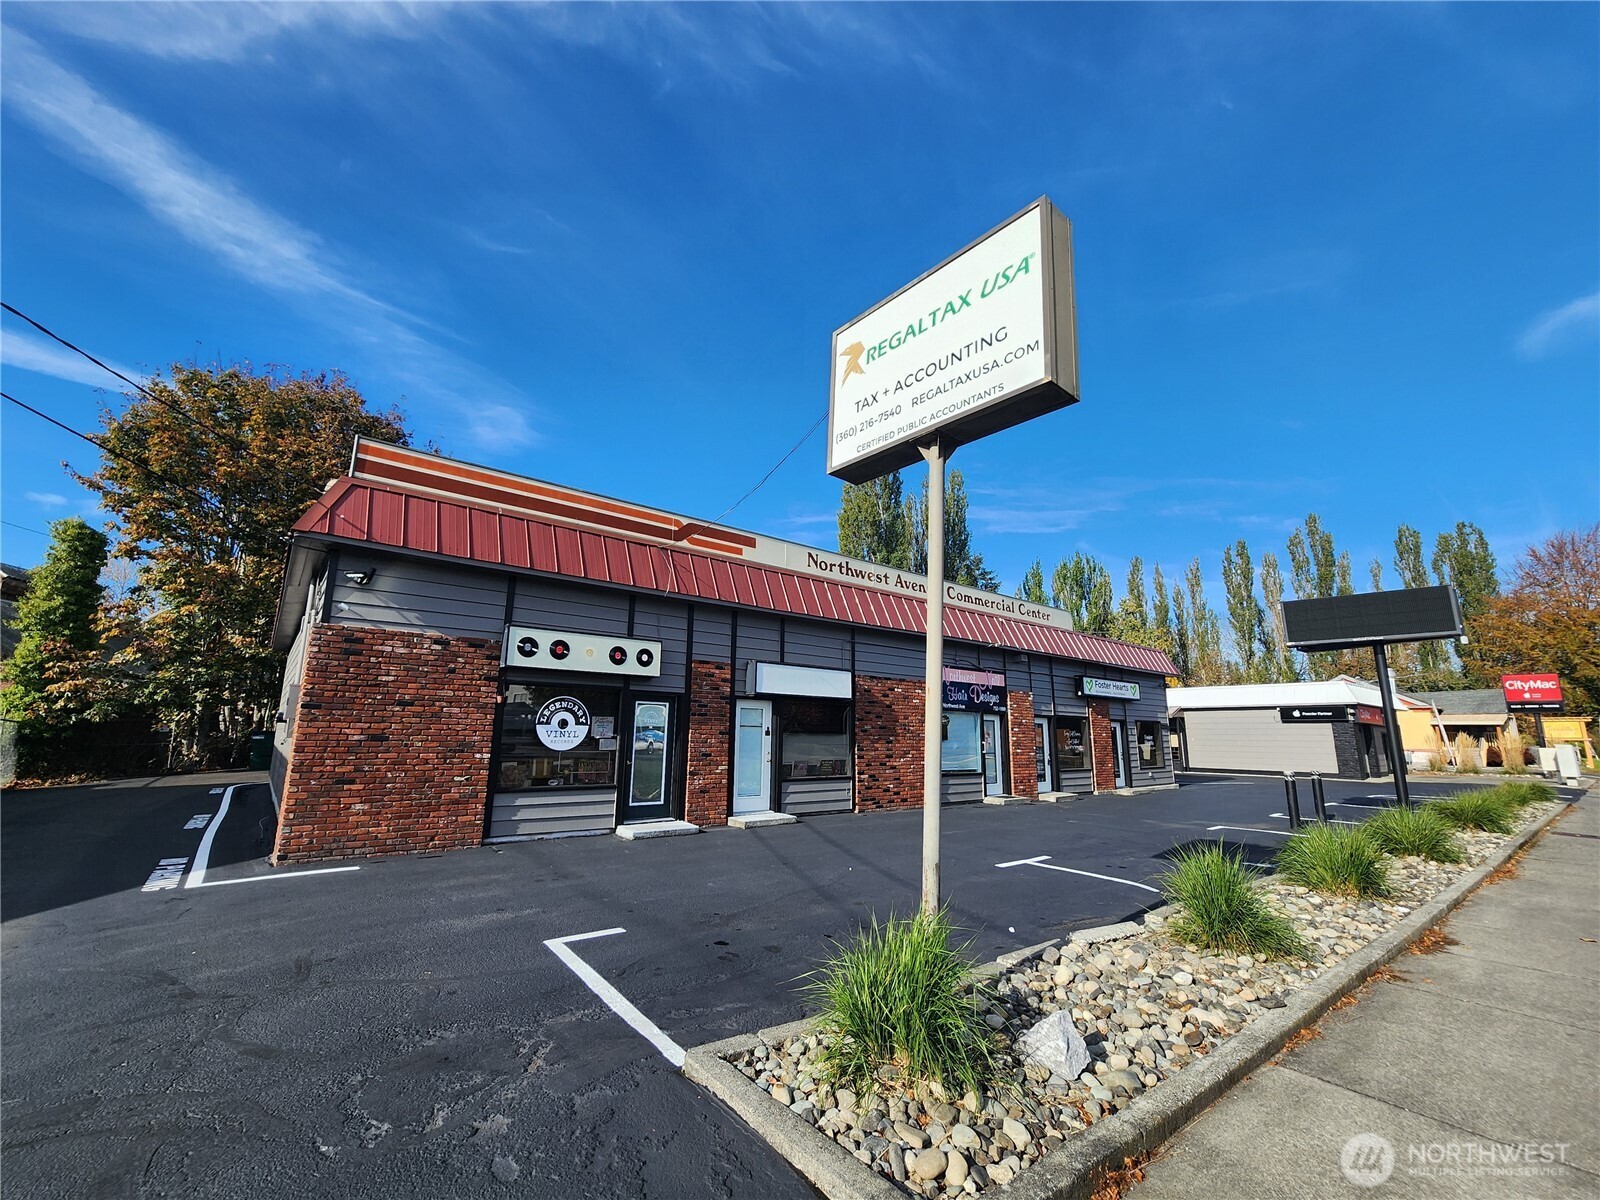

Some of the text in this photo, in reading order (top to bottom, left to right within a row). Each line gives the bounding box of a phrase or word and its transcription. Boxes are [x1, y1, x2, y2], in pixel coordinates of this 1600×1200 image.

[866, 289, 972, 365] REGALTAX
[835, 340, 1040, 445] (360) 216-7540 REGALTAXUSA.COM
[854, 326, 1008, 414] TAX + ACCOUNTING
[856, 383, 1005, 453] CERTIFIED PUBLIC ACCOUNTANTS
[807, 552, 1051, 621] Northwest Aven Commercial Center
[947, 685, 1000, 706] Hair Designs
[1094, 680, 1129, 692] Foster Hearts
[1505, 680, 1557, 691] CityMac
[540, 701, 586, 723] LEGENDARY
[545, 730, 579, 738] VINYL
